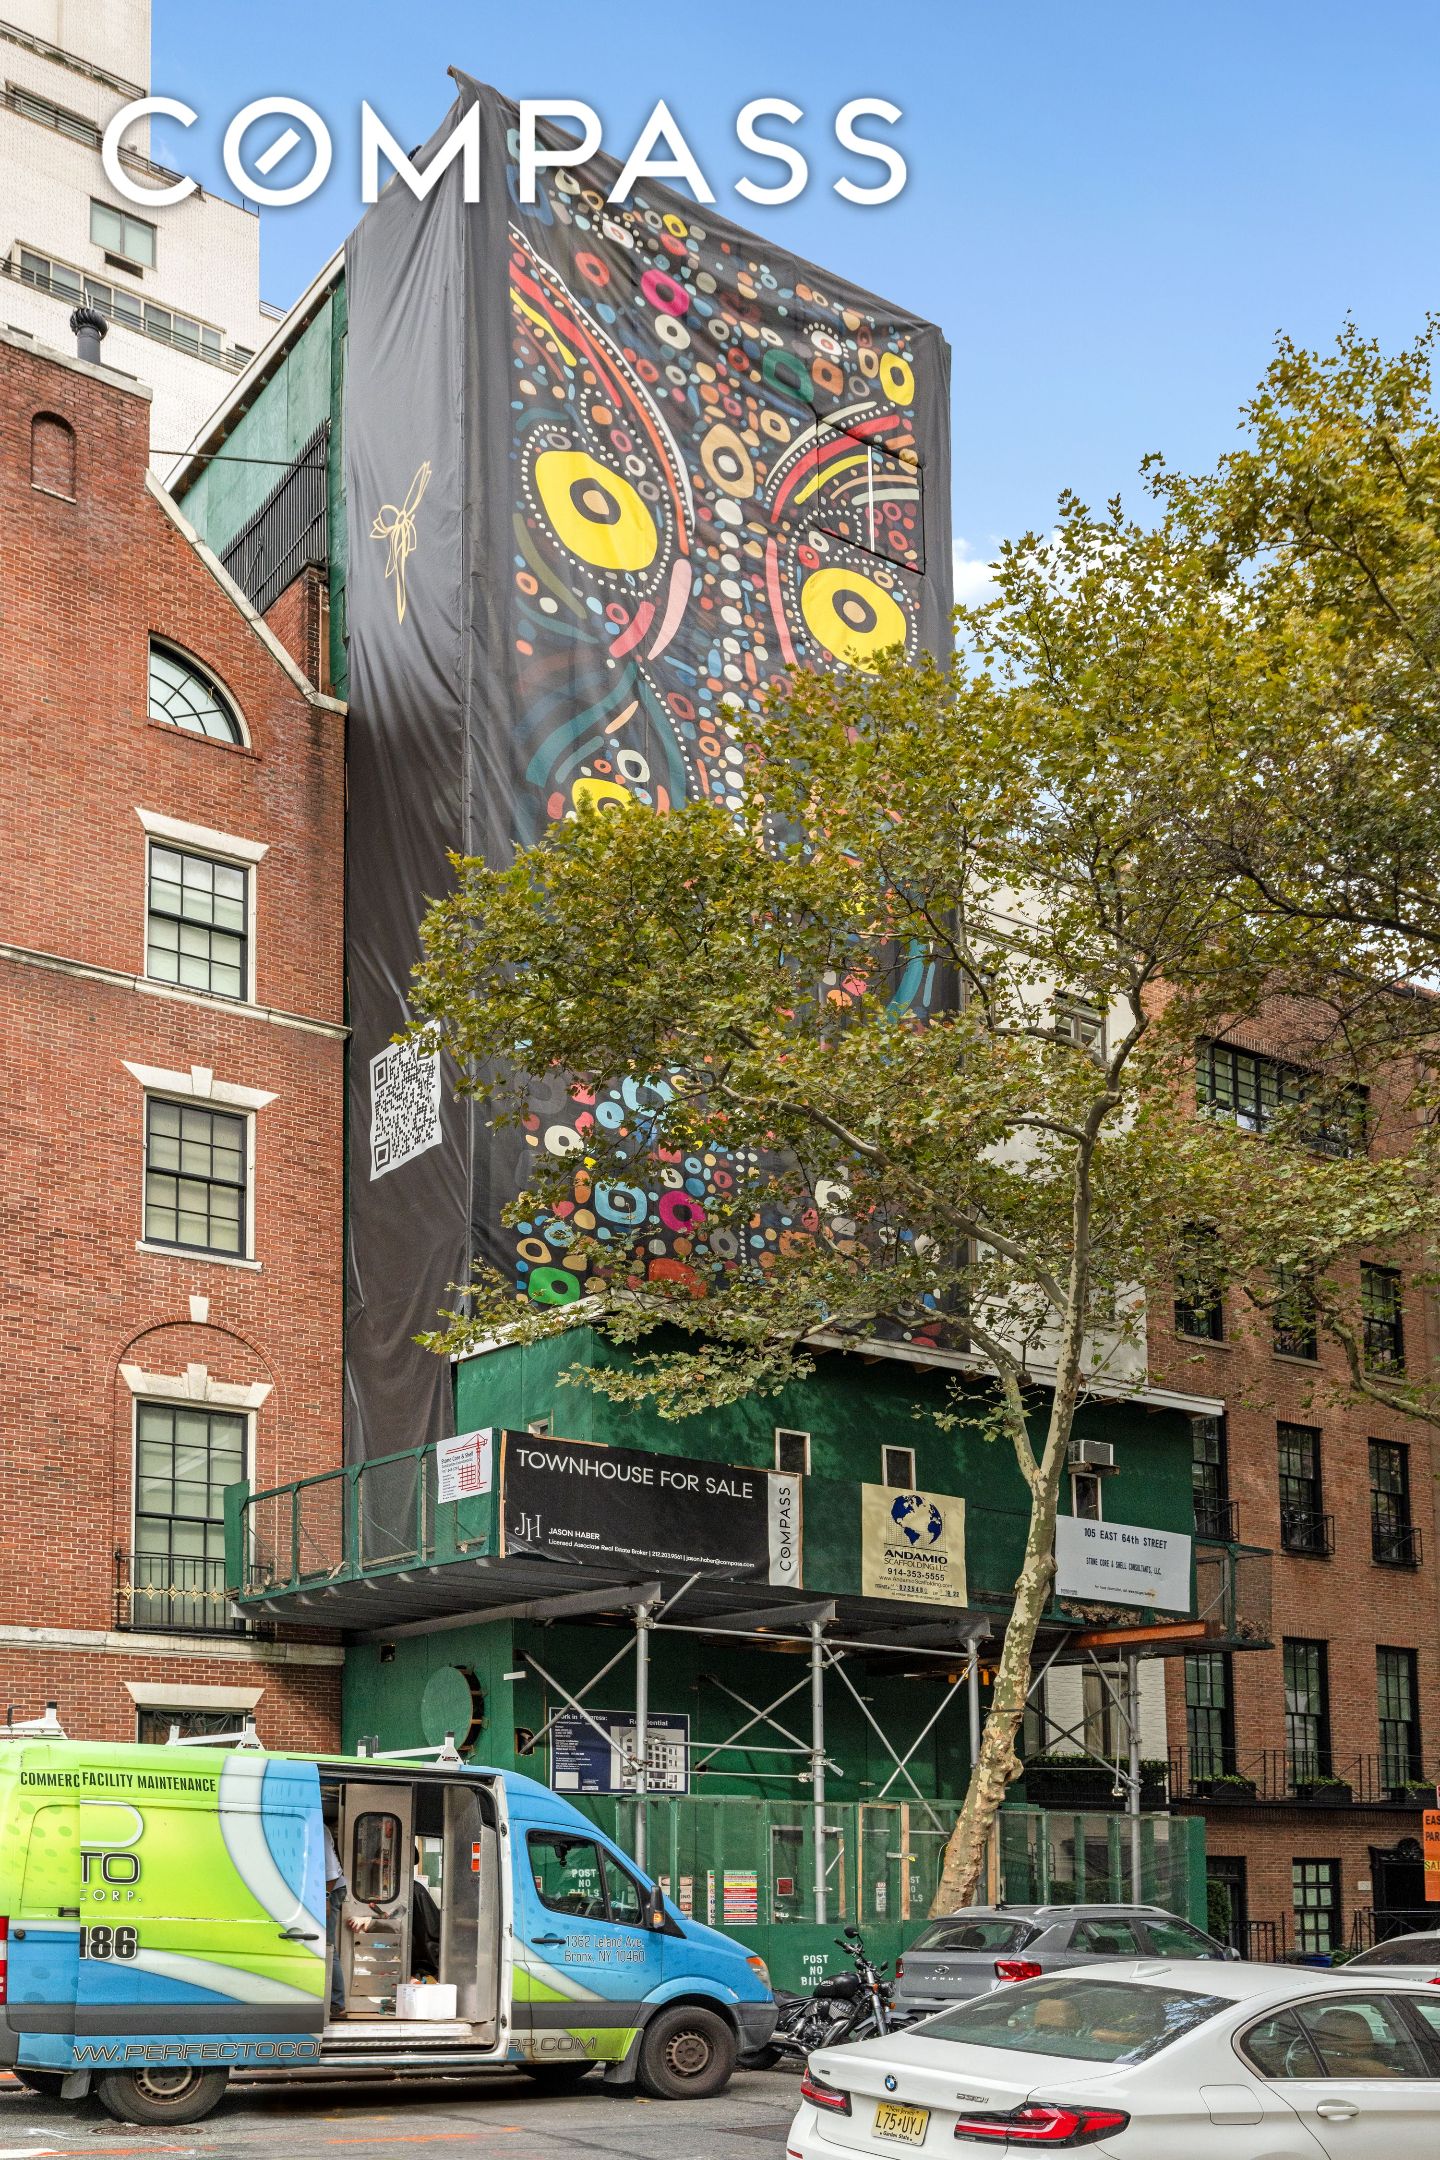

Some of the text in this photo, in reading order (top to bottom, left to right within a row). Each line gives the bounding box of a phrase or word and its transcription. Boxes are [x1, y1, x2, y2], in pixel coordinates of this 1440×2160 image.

[516, 1448, 754, 1499] TOWNHOUSE FOR SALE
[548, 1527, 601, 1540] JASON HABER
[779, 1486, 792, 1572] COMPASS
[1084, 1527, 1168, 1550] 105 EAST 64th STREET
[548, 1538, 573, 1547] Licensed
[573, 1541, 600, 1551] Associate
[600, 1544, 614, 1552] Real
[631, 1547, 648, 1556] Broker
[884, 1549, 948, 1565] ANDAMIO
[1099, 1558, 1110, 1568] CORE
[884, 1557, 948, 1572] SCAFFOLDING LLC
[887, 1567, 945, 1582] 914-353-5555
[82, 1771, 134, 1787] FACILITY
[137, 1774, 217, 1792] MAINTENANCE
[571, 1868, 597, 1878] POST
[578, 1878, 591, 1888] NO
[565, 1935, 591, 1948] 1362
[593, 1935, 623, 1948] Leland
[564, 1950, 646, 1963] Bronx, NY 10460
[803, 1954, 829, 1965] POST
[809, 1965, 823, 1975] NO
[801, 1976, 822, 1986] BIL
[73, 2041, 322, 2062] WW.PERFECTOCO
